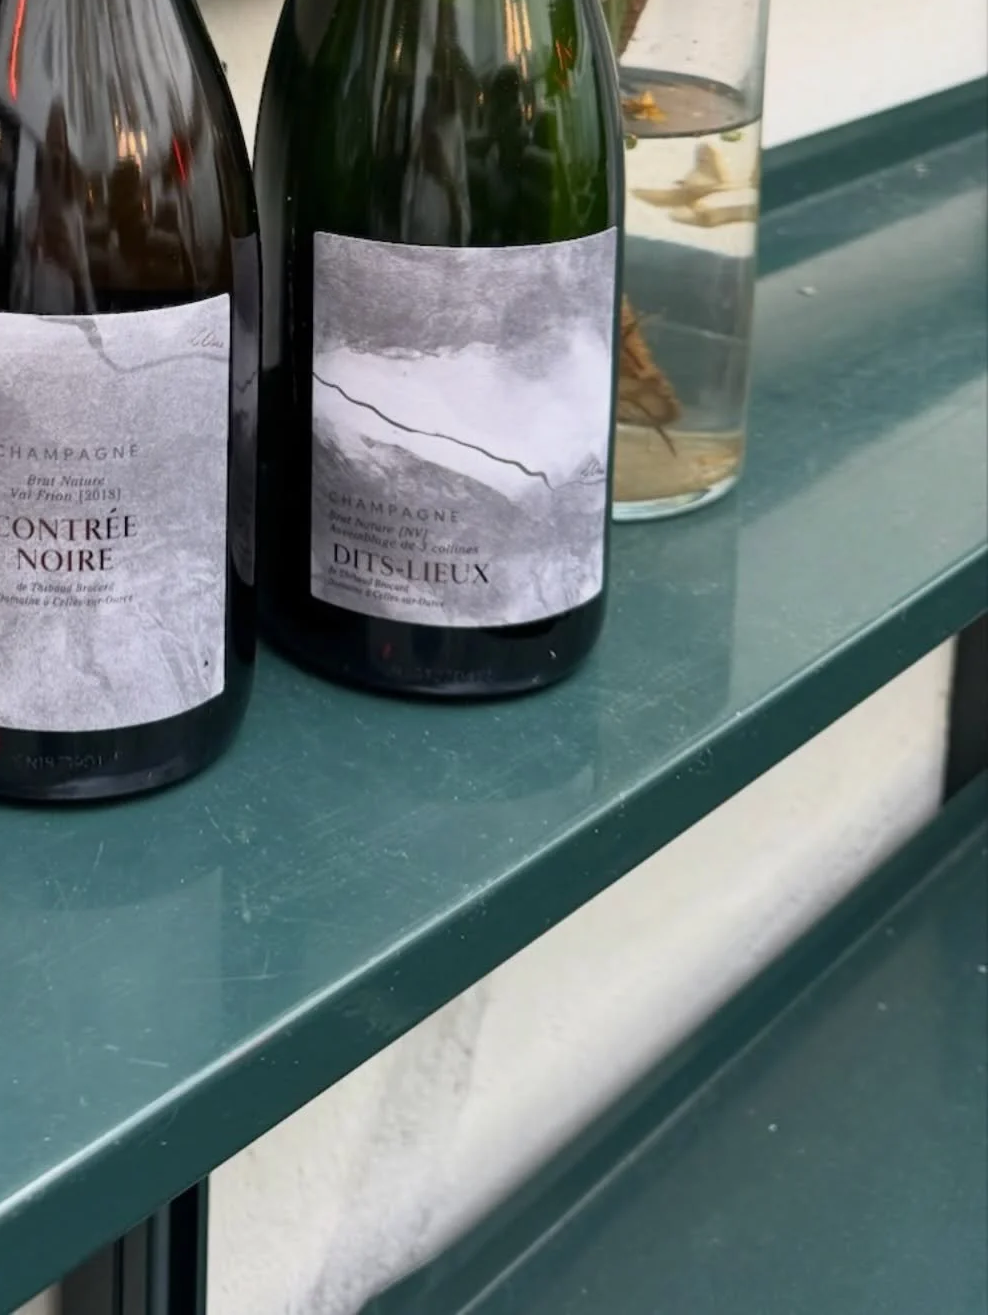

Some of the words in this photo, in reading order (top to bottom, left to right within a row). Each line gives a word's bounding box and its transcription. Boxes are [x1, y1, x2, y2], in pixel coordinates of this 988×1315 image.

[27, 473, 56, 487] Brut
[61, 475, 105, 486] Nature
[11, 487, 33, 501] Val
[36, 489, 73, 502] Frion
[79, 487, 122, 504] [2018]
[328, 490, 461, 523] CHAMPAGNE
[16, 547, 114, 572] NOIRE
[333, 542, 490, 584] DITS-LIEUX
